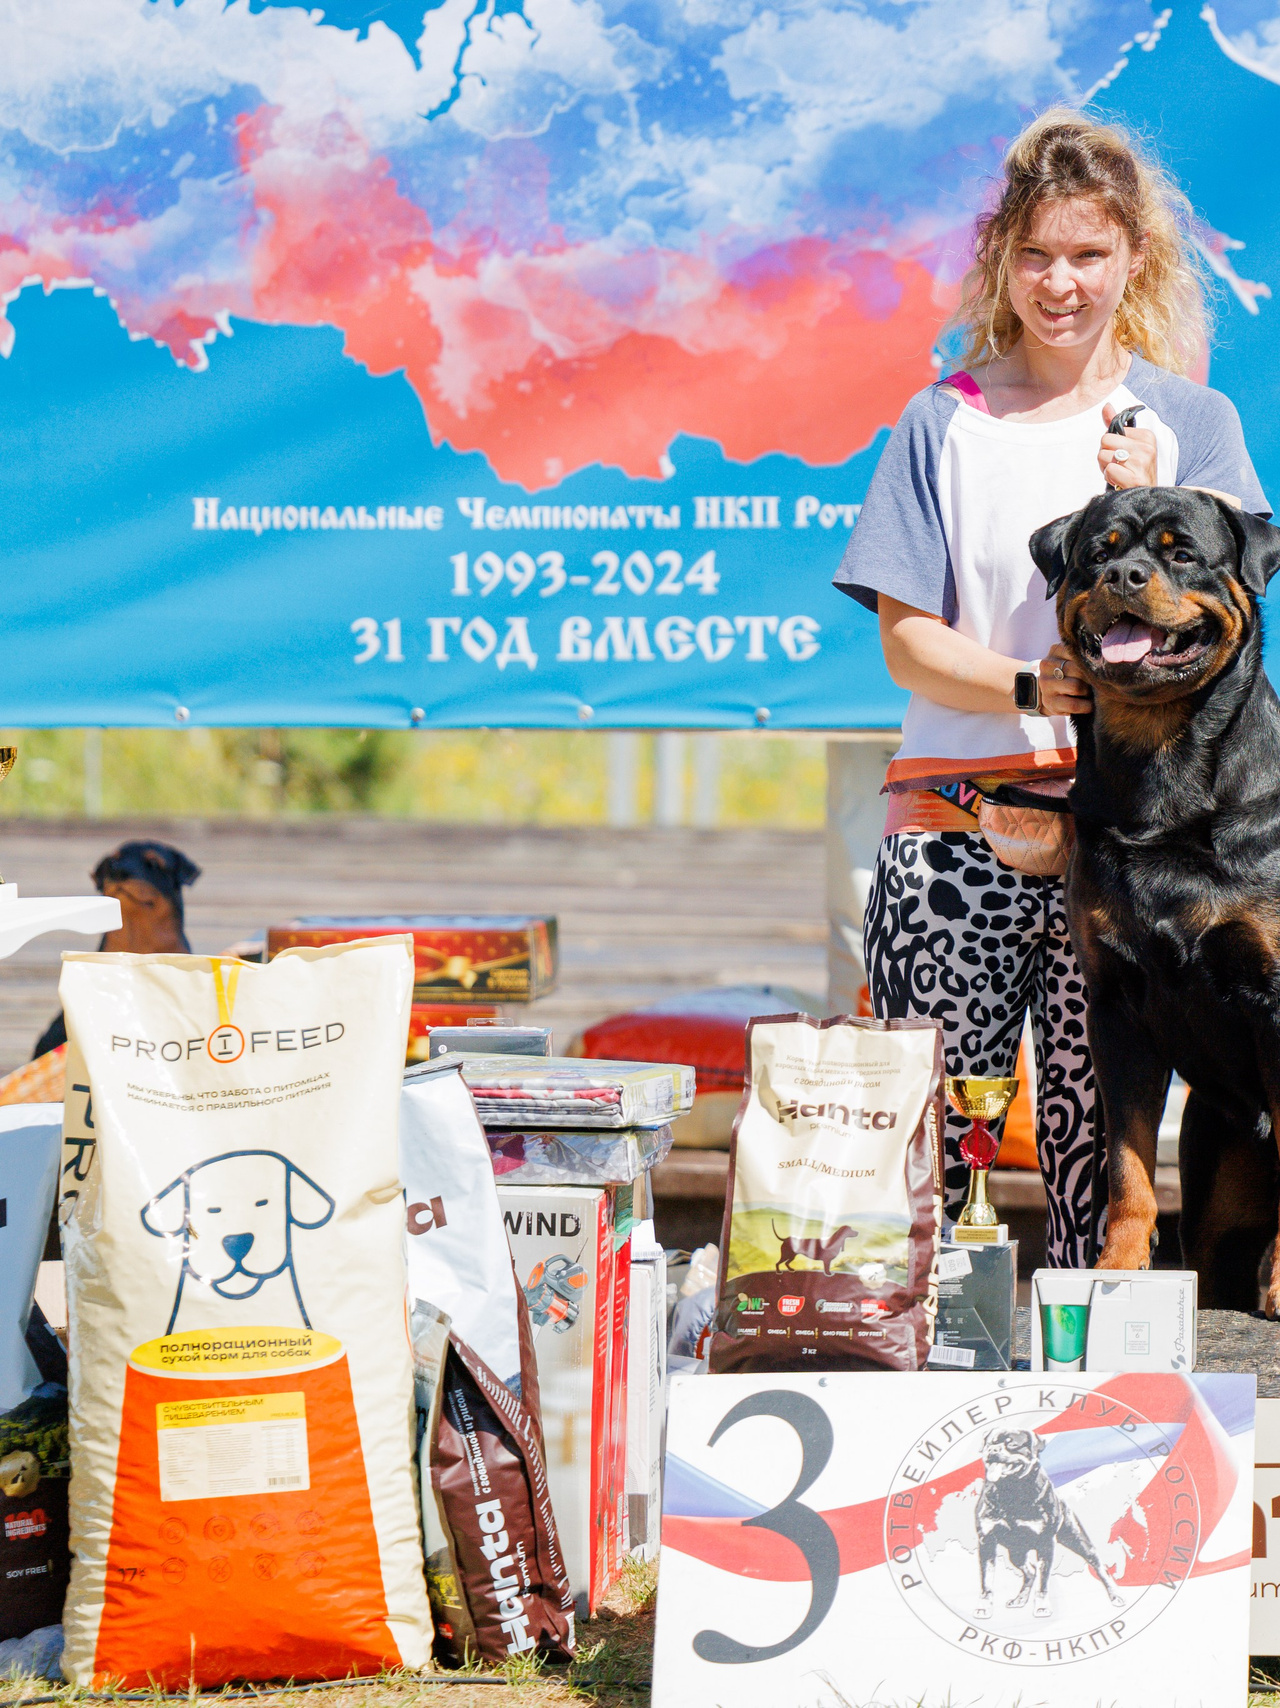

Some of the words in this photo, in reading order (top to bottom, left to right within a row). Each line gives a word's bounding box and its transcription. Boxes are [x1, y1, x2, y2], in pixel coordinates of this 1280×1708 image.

[192, 497, 445, 536] Национальные
[456, 497, 681, 530] Чемпионаты
[693, 496, 781, 529] НКП
[449, 550, 721, 597] 1993-2024
[351, 616, 405, 664] 31
[426, 616, 538, 671] ГОД
[556, 615, 822, 663] ВМЕСТЕ
[197, 1091, 218, 1100] ЧТО
[220, 1087, 262, 1099] ЗАБОТА
[264, 1085, 272, 1094] О
[274, 1072, 331, 1093] ПИТОМЦАХ
[800, 1077, 848, 1087] говядиной
[197, 1104, 205, 1112] С
[206, 1096, 284, 1112] ПРАВИЛЬНОГО
[286, 1081, 332, 1101] ПИТАНИЯ
[776, 1099, 898, 1131] Hanta
[777, 1158, 876, 1178] SMALL/MEDIUM
[782, 1298, 800, 1306] FRESH
[782, 1305, 797, 1313] MEAT
[160, 1335, 313, 1354] полнорационный
[161, 1350, 201, 1365] сухой
[203, 1351, 239, 1362] корм
[241, 1349, 268, 1361] для
[271, 1346, 312, 1358] собак
[801, 1347, 807, 1355] 3
[163, 1408, 246, 1421] ПИЩЕВАРЕНИЕМ
[171, 1399, 264, 1412] ЧУВСТВИТЕЛЬНЫМ
[455, 1388, 474, 1422] рисом
[467, 1430, 491, 1487] говядиной
[888, 1394, 1013, 1592] РОТВЕЙЛЕР
[1038, 1389, 1139, 1435] КЛУБ
[1147, 1440, 1196, 1592] РОССИИ
[5, 1518, 34, 1530] NATURAL
[5, 1523, 47, 1538] INGREDIENTS
[692, 1389, 841, 1664] 3
[6, 1571, 24, 1579] SOY
[25, 1565, 48, 1576] FREE
[475, 1499, 537, 1655] Hanta
[958, 1618, 1127, 1663] РКФ-НКПР
